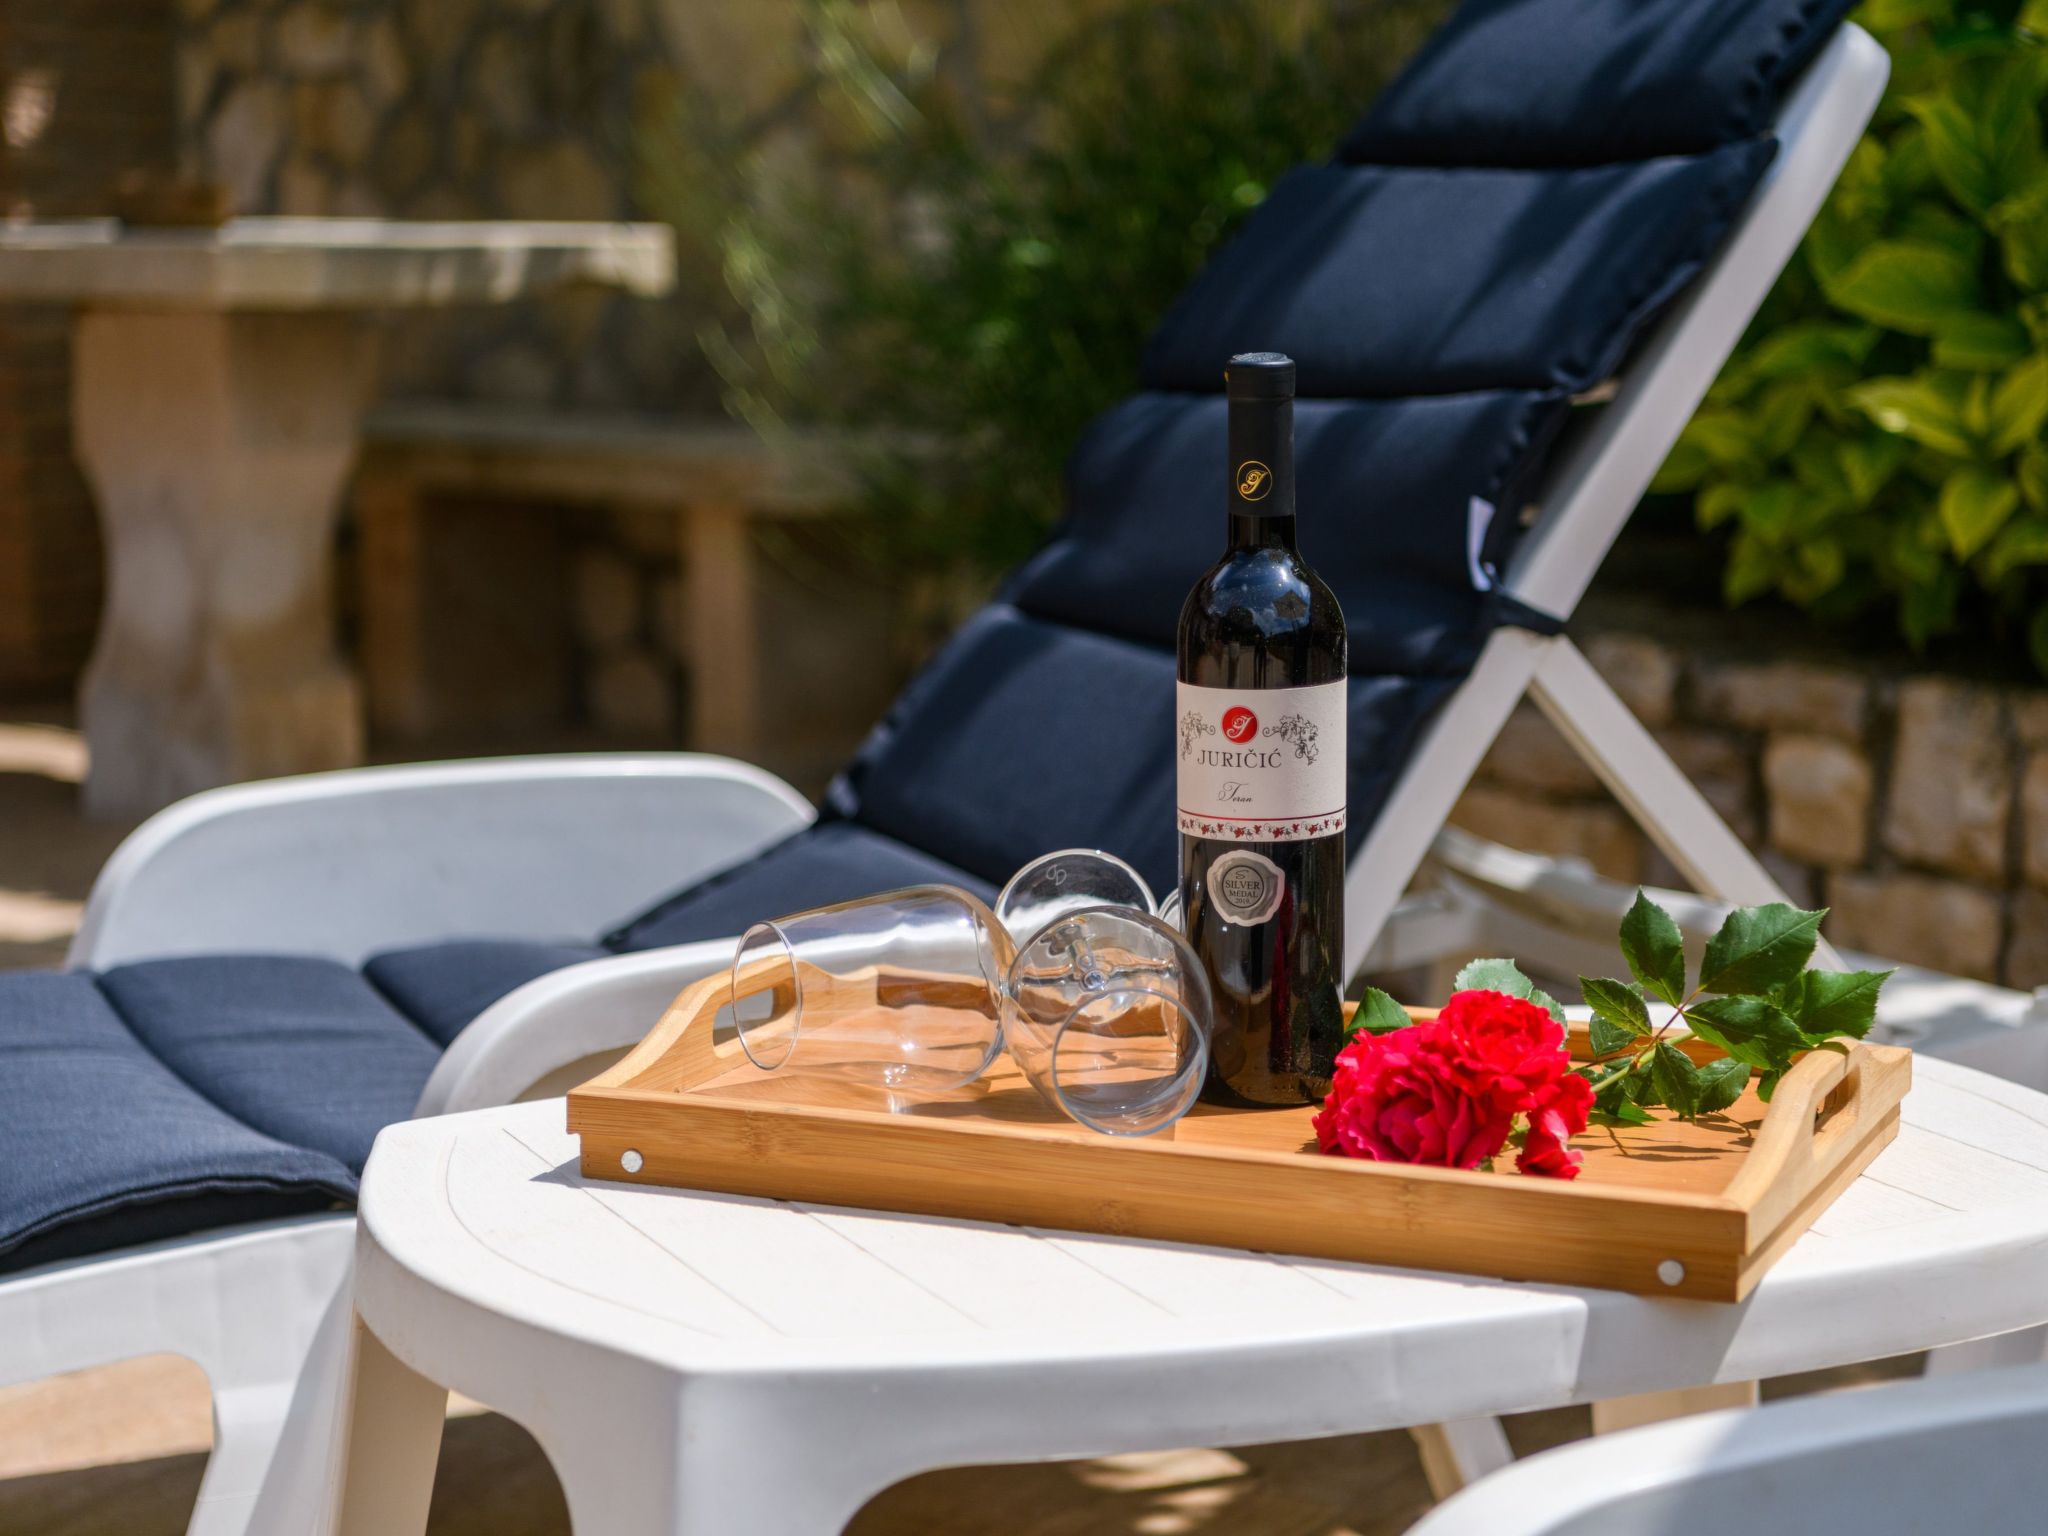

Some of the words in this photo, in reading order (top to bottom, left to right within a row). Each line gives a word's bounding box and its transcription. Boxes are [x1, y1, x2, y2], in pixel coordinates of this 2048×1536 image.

[1197, 748, 1282, 768] JURIČIĆ
[1218, 781, 1253, 802] Teran
[1225, 879, 1260, 889] SILVER
[1229, 889, 1258, 898] MEDAL
